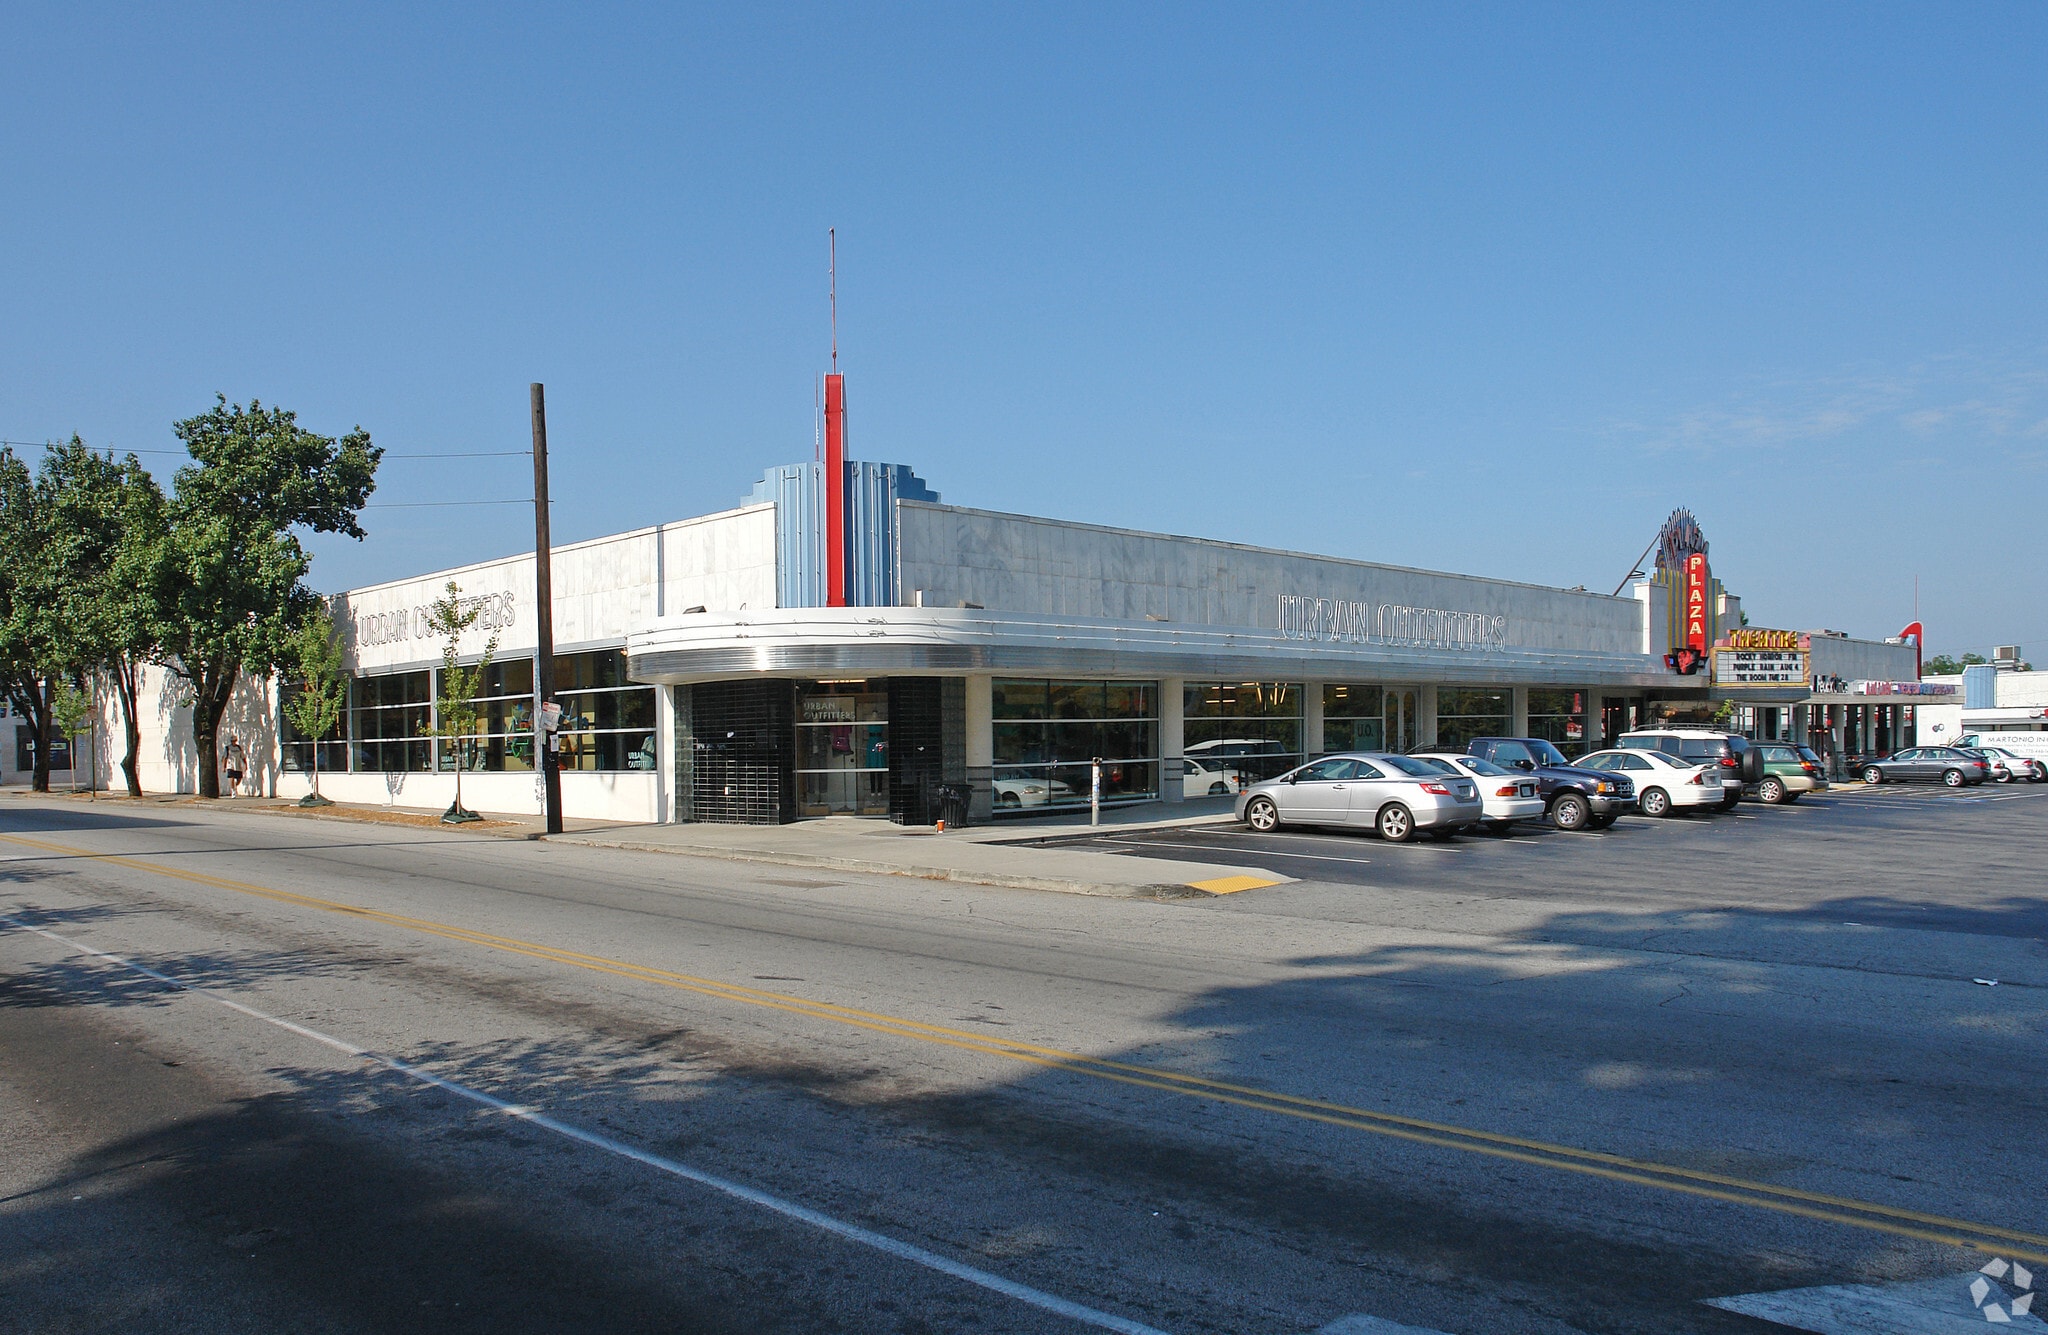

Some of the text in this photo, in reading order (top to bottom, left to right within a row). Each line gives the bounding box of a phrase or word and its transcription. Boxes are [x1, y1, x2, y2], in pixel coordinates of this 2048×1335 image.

[1689, 557, 1703, 634] PLAZA
[360, 608, 408, 647] URBAN
[1278, 594, 1506, 652] URBAN OUTFITTERS
[1729, 629, 1798, 648] THEATRE
[803, 702, 835, 710] URBAN
[803, 711, 856, 720] OUTFITTERS
